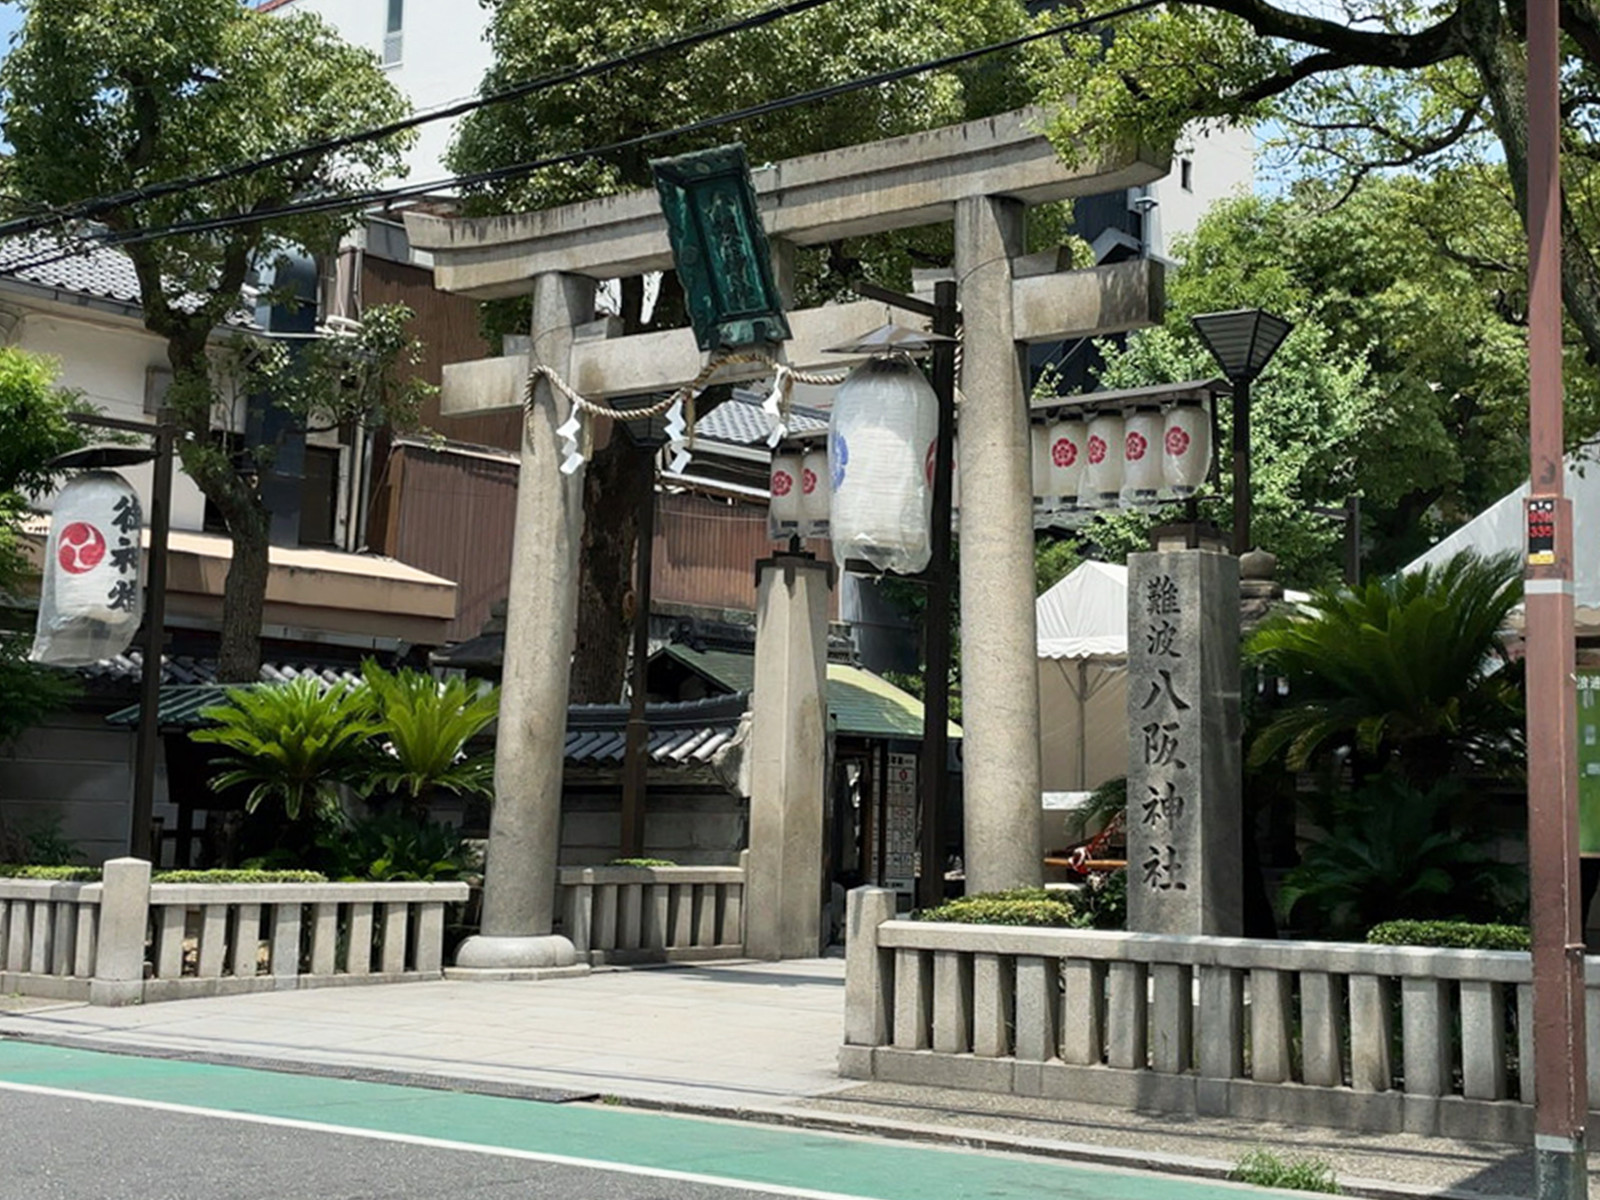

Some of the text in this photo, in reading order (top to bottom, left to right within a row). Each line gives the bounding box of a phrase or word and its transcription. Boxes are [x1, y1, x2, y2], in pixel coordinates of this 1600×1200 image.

[1142, 575, 1190, 891] 難波八阪神社
